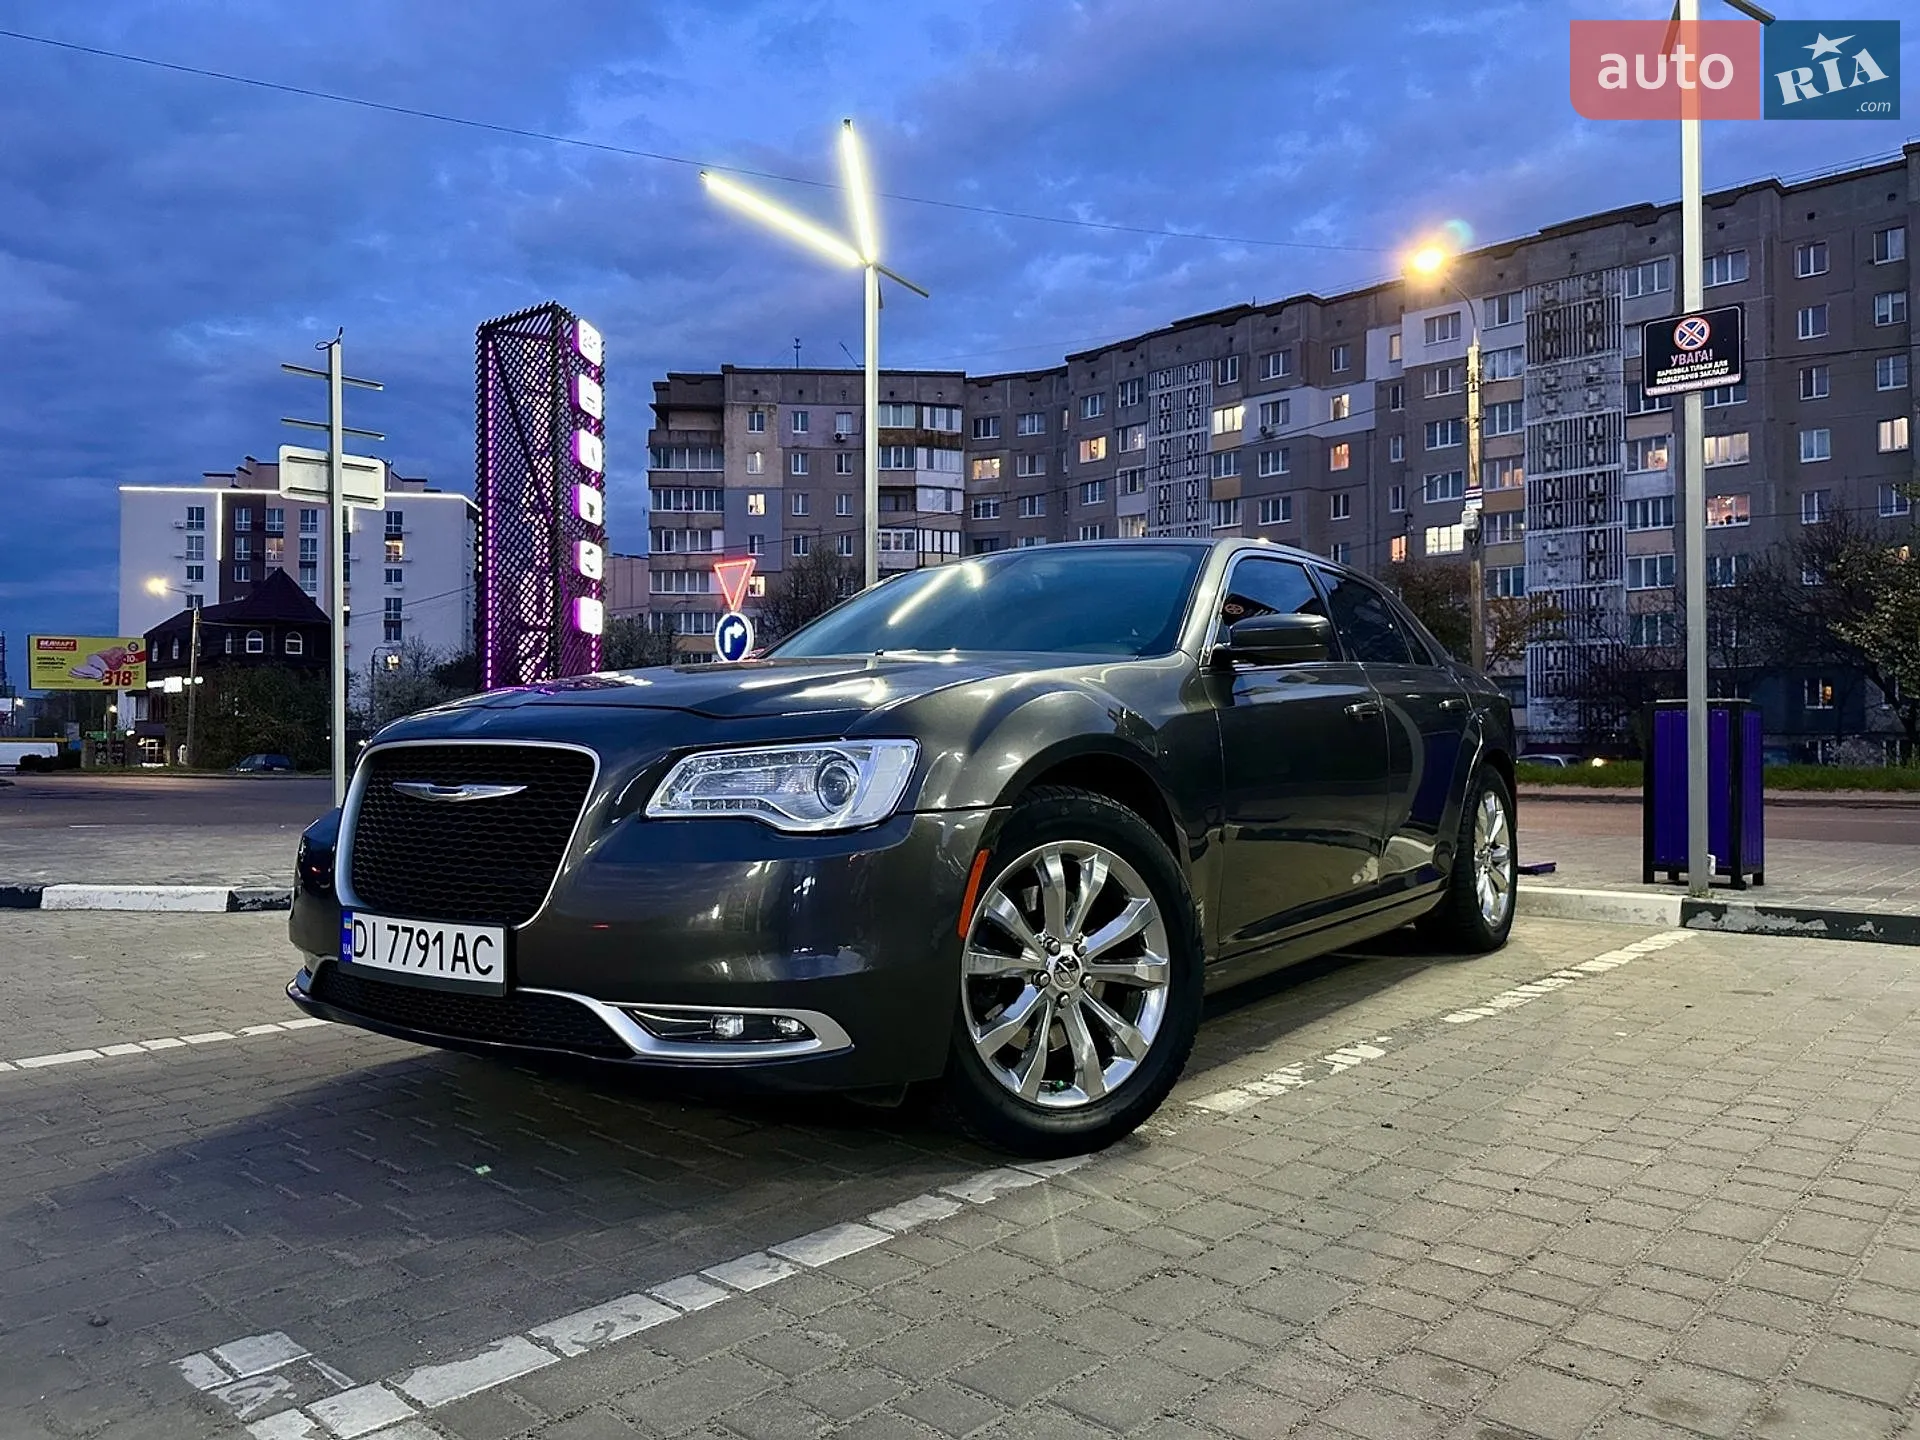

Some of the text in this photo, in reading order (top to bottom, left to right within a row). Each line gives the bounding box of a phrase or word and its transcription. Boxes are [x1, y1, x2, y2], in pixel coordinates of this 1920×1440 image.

[1670, 348, 1713, 367] УВАГА!
[1657, 366, 1690, 377] ПАРКОВКА
[1690, 362, 1712, 372] ТІЛЬКИ
[1699, 367, 1729, 377] ЗАКЛАДУ
[102, 670, 133, 686] 318
[342, 943, 353, 956] UA
[353, 919, 494, 976] DI 7791 AC
